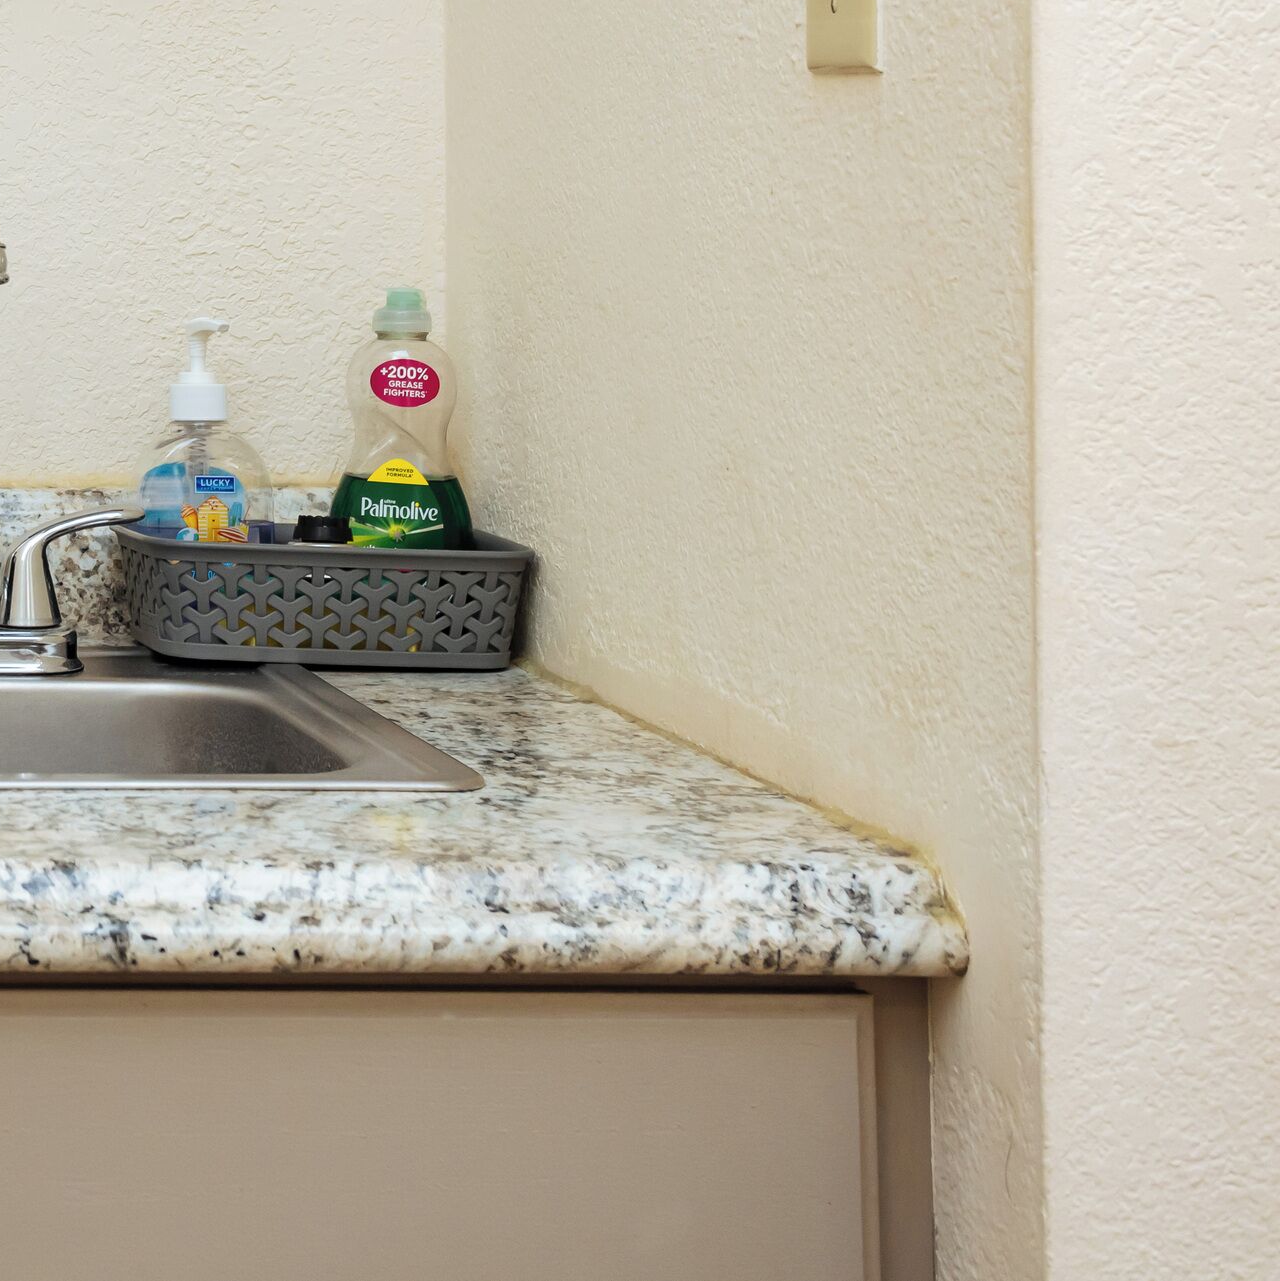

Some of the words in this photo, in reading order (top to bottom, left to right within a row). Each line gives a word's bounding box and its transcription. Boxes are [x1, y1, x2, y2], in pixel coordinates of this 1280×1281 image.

[380, 365, 429, 381] +200%
[388, 380, 423, 389] GREASE
[200, 478, 230, 487] LUCKY
[360, 496, 439, 521] Palmolive
